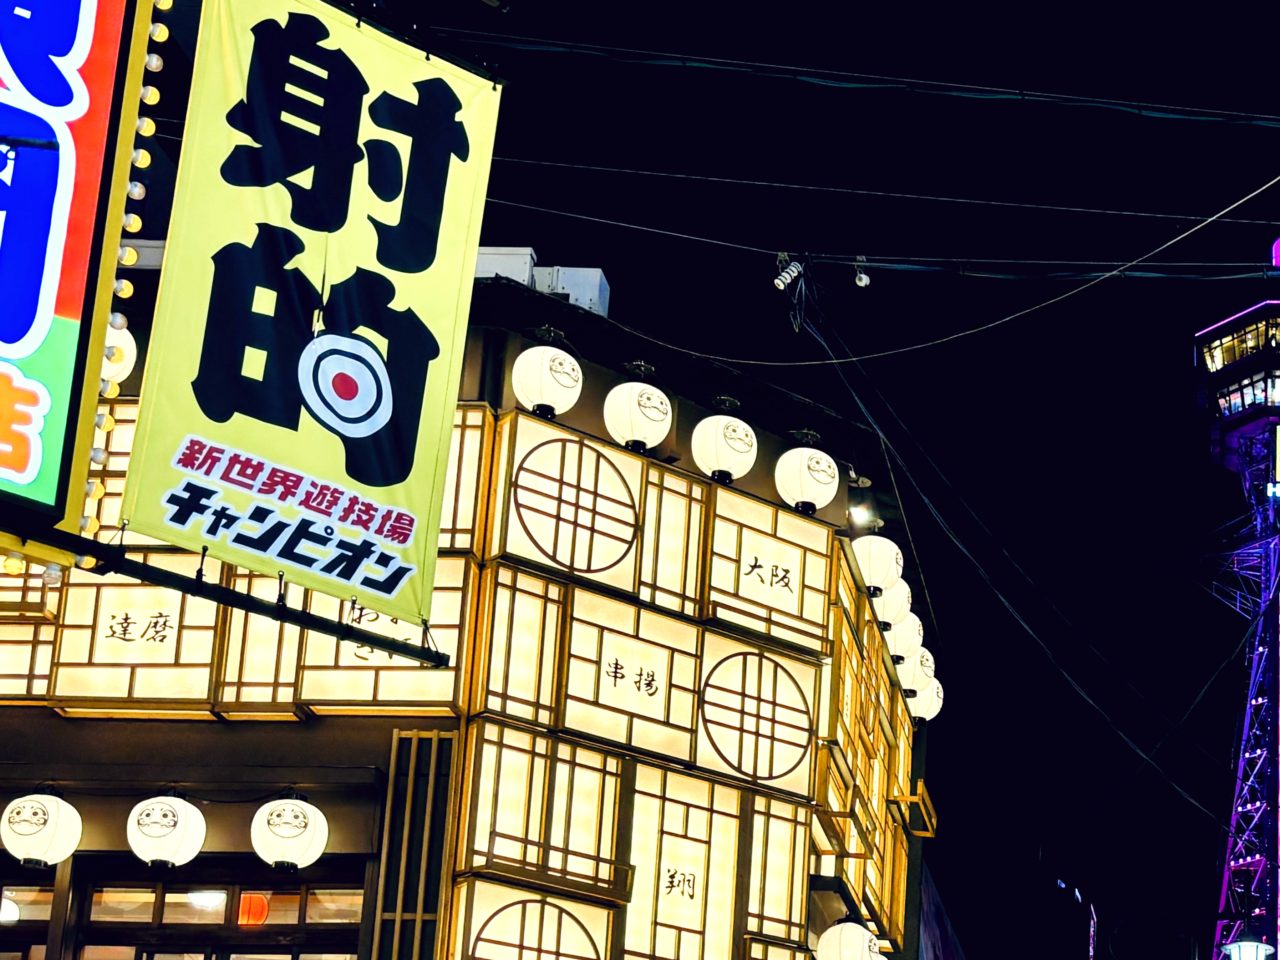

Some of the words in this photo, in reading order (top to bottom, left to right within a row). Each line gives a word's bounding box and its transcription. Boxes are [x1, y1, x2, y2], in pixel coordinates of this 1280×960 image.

[191, 12, 470, 487] 射的
[177, 438, 415, 545] 新世界遊技場
[164, 482, 416, 594] チャンピオン
[743, 556, 795, 594] 大阪
[105, 611, 173, 643] 達磨
[605, 657, 660, 698] 串揚
[665, 869, 696, 899] 翔
